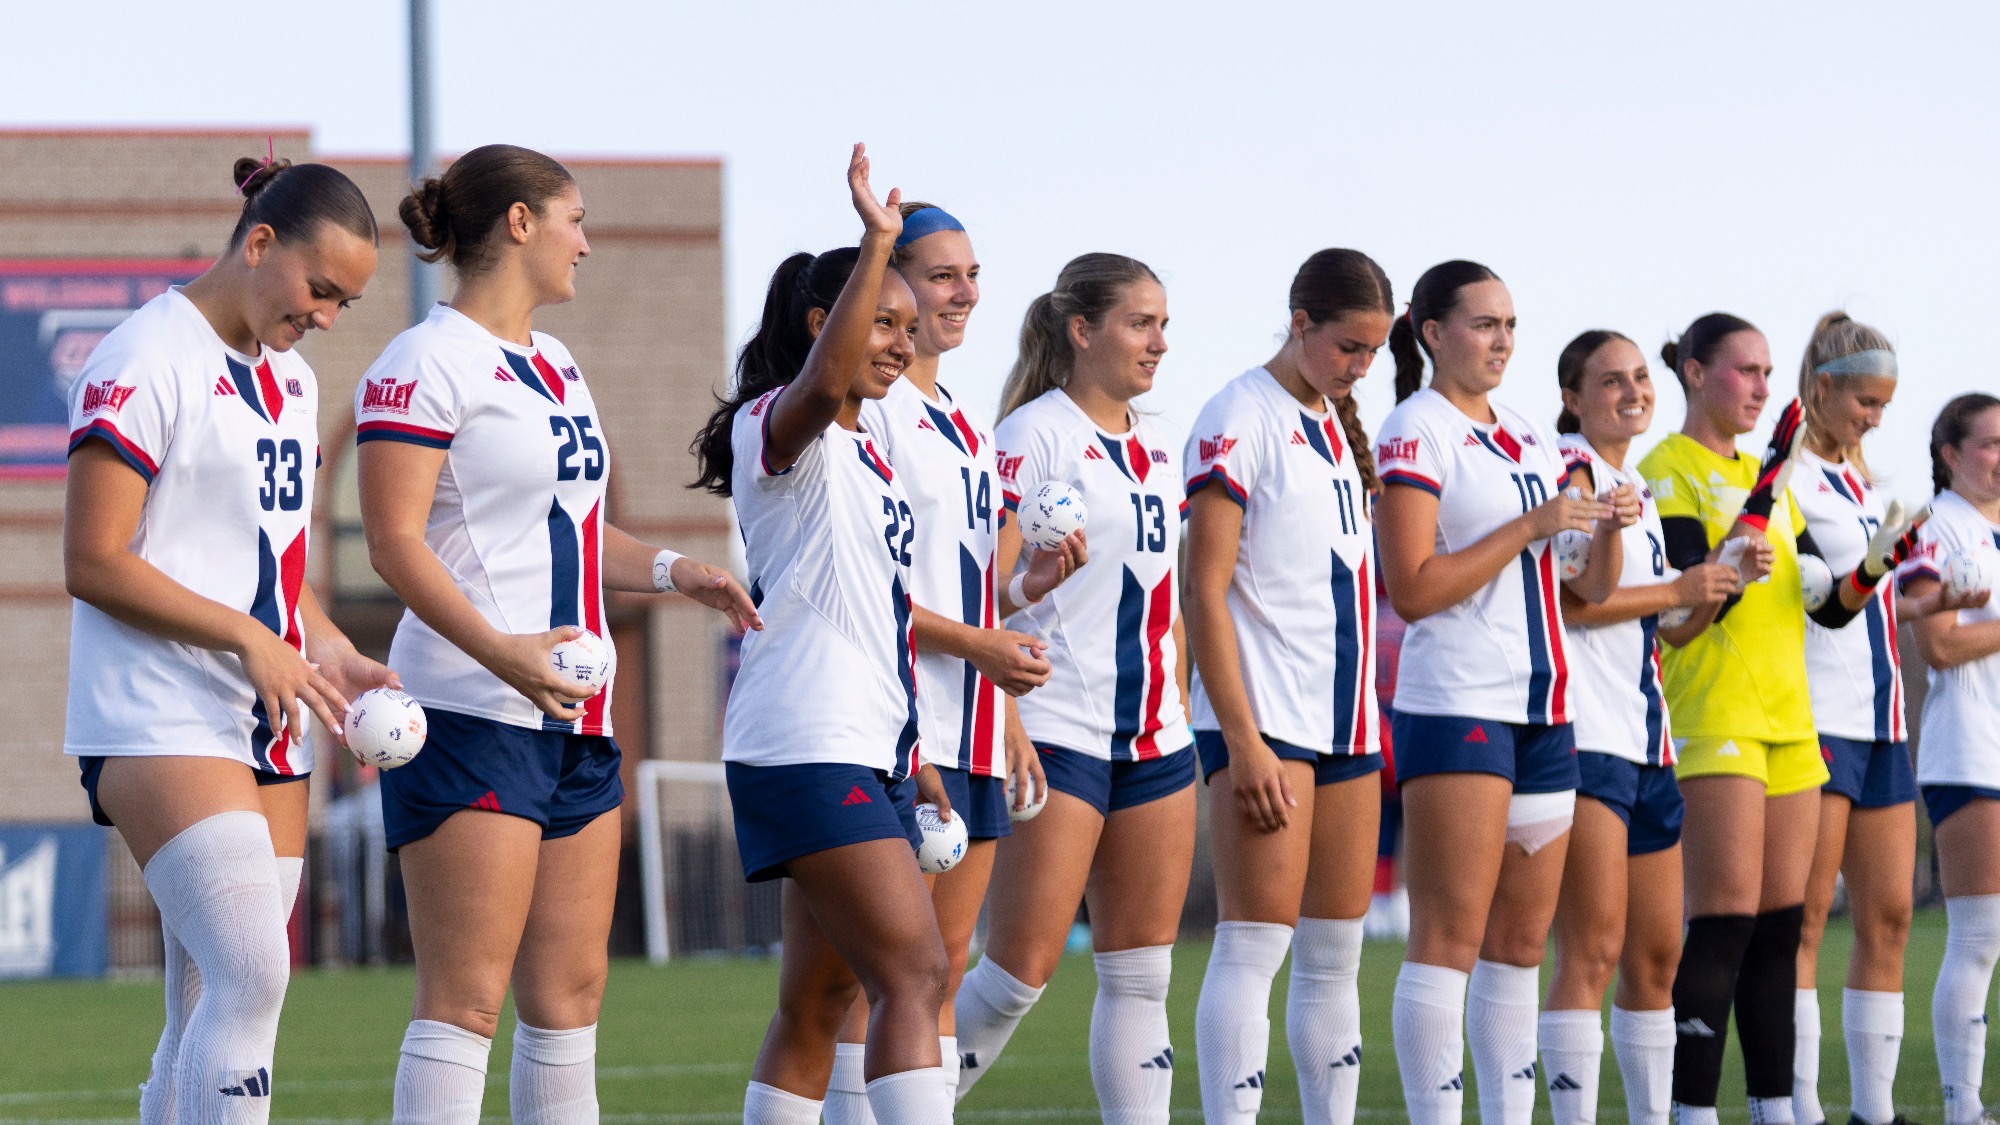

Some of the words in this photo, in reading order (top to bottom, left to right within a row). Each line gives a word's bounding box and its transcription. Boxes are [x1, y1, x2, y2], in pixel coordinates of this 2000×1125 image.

[83, 381, 137, 412] VALLEY
[363, 379, 418, 409] VALLEY
[257, 438, 303, 511] 33
[549, 415, 605, 481] 25
[881, 495, 914, 567] 22
[960, 466, 991, 535] 14
[1130, 492, 1166, 553] 13
[1332, 478, 1358, 535] 11
[1645, 529, 1664, 576] 8
